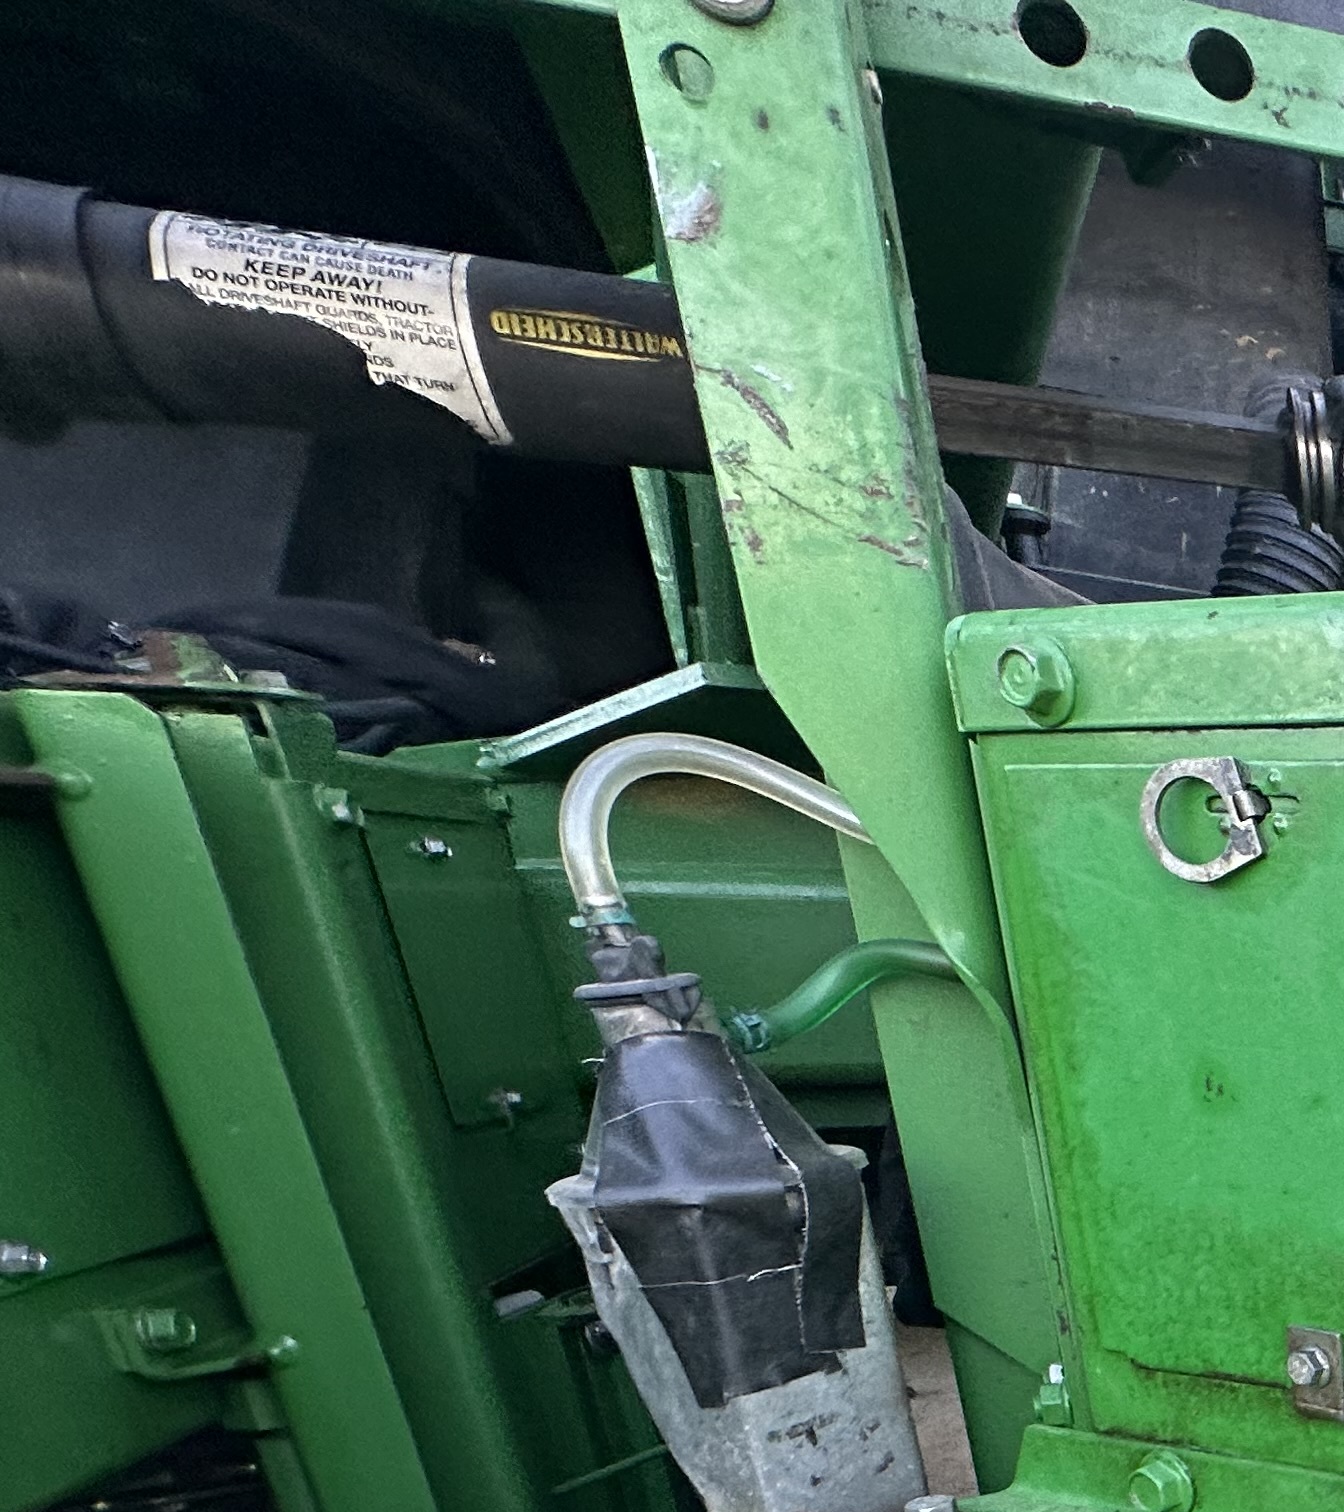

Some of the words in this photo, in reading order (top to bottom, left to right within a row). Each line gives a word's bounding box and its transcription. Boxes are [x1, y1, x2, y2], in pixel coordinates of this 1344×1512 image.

[244, 258, 306, 280] KEEP
[310, 270, 382, 293] AWAY!
[279, 250, 310, 264] CAN
[315, 255, 363, 272] CAUSE
[367, 263, 414, 281] DEATH
[191, 266, 218, 281] DO
[222, 272, 261, 288] NOT
[264, 278, 346, 302] OPERATE
[218, 288, 311, 313] DRIVESHAFT
[385, 314, 454, 337] TRACTOR
[322, 318, 387, 338] SHIELDS
[389, 329, 406, 342] IN
[408, 332, 457, 350] PLACE
[489, 309, 684, 358] WALTERSCHEID
[413, 376, 455, 391] TURN
